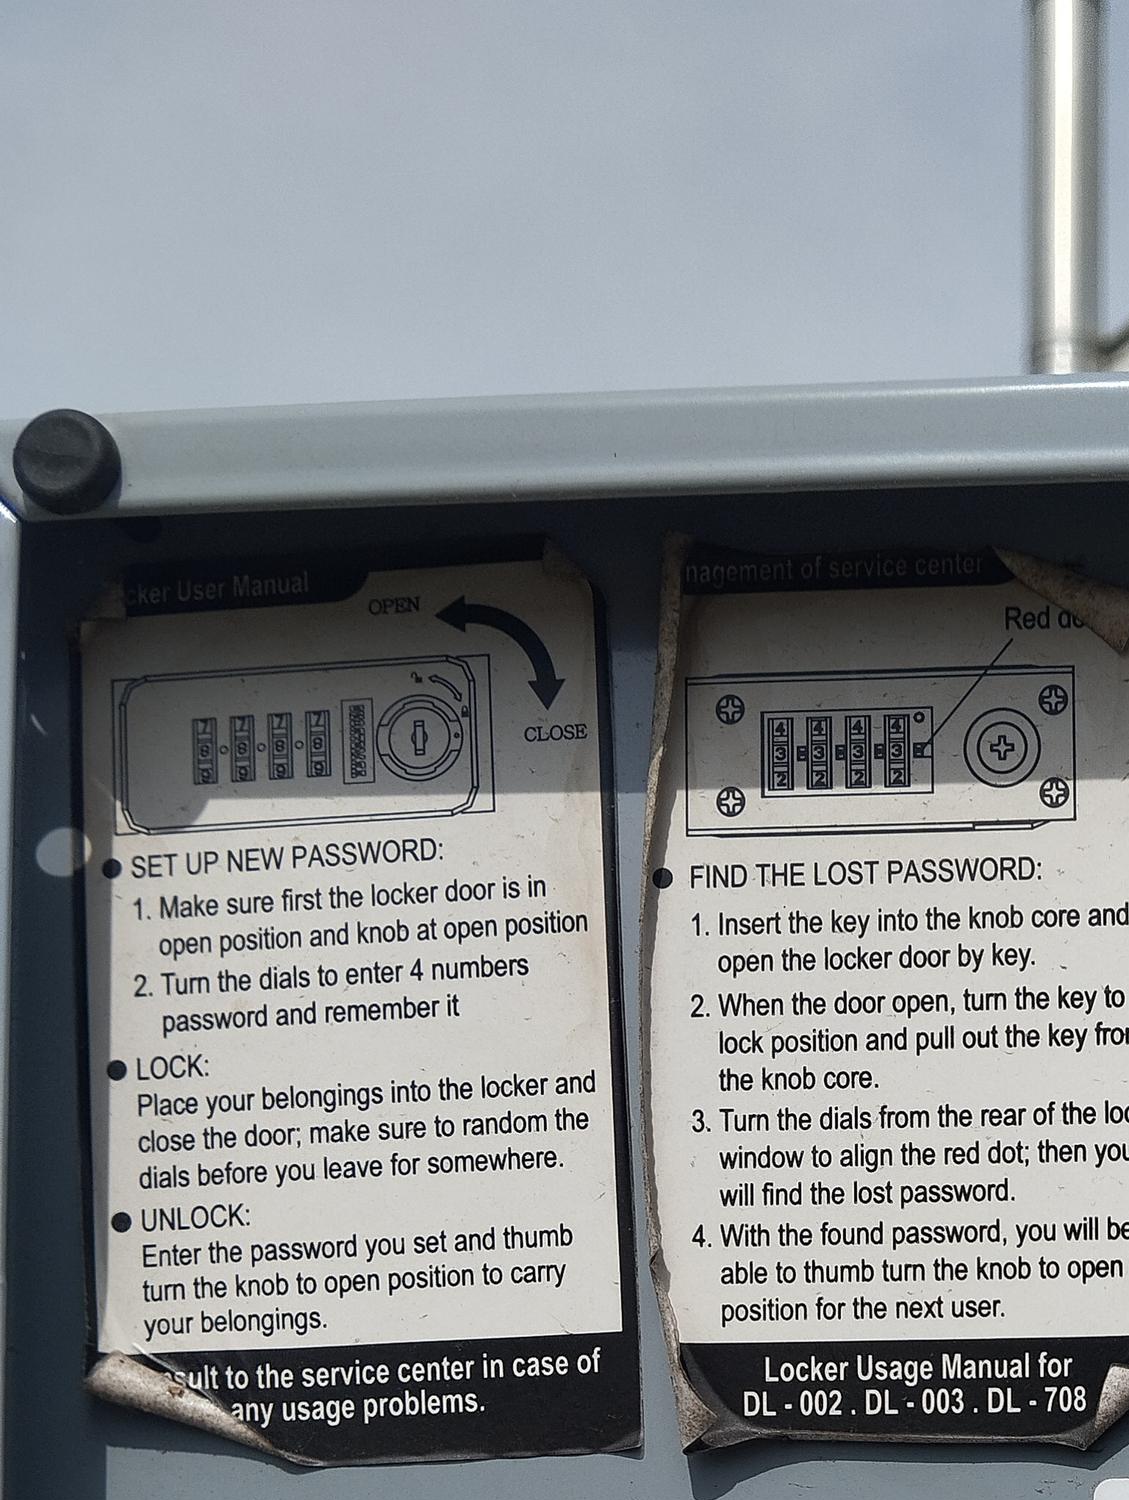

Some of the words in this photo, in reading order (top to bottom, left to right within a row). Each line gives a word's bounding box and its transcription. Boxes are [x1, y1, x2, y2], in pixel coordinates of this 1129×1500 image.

[801, 553, 821, 579] of
[829, 553, 905, 581] service
[916, 555, 982, 577] center
[177, 579, 225, 602] User
[233, 571, 309, 597] Manual
[368, 597, 420, 615] OPEN
[1005, 606, 1050, 630] Red
[523, 724, 588, 743] CLOSE
[130, 852, 179, 880] SET
[185, 850, 219, 876] UP
[226, 845, 285, 873] NEW
[291, 837, 444, 873] PASSWORD:
[690, 862, 748, 890] FIND
[754, 862, 806, 888] THE
[813, 860, 880, 887] LOST
[887, 855, 1042, 885] PASSWORD:
[132, 897, 152, 921] 1.
[159, 893, 220, 920] Make
[226, 894, 275, 916] sure
[280, 887, 324, 913] first
[327, 885, 365, 910] the
[370, 881, 439, 907] locker
[444, 878, 497, 903] door
[502, 875, 521, 900] is
[527, 873, 547, 899] in
[158, 935, 213, 962] open
[219, 925, 302, 959] position
[309, 921, 350, 948] and
[356, 918, 410, 945] knob
[416, 917, 438, 942] at
[443, 918, 498, 946] open
[504, 909, 589, 943] position
[691, 912, 710, 937] 1.
[718, 911, 782, 936] Insert
[787, 909, 824, 935] the
[830, 908, 871, 940] key
[877, 907, 919, 933] into
[924, 906, 961, 932] the
[968, 903, 1024, 930] knob
[1030, 908, 1081, 929] core
[1087, 900, 1129, 928] and
[717, 953, 774, 980] open
[780, 947, 817, 972] the
[824, 945, 894, 971] locker
[898, 944, 952, 969] door
[957, 942, 985, 974] by
[991, 941, 1036, 973] key.
[136, 1053, 210, 1081] LOCK:
[137, 1092, 199, 1122] Place
[205, 1092, 256, 1120] your
[261, 1082, 384, 1114] belongings
[390, 1079, 432, 1104] into
[437, 1076, 474, 1102] the
[480, 1072, 549, 1100] locker
[555, 1068, 596, 1095] and
[140, 1202, 251, 1233] UNLOCK:
[141, 1243, 203, 1269] Enter
[207, 1239, 243, 1265] the
[250, 1233, 358, 1269] password
[364, 1236, 406, 1264] you
[413, 1229, 448, 1255] set
[454, 1226, 496, 1253] and
[502, 1222, 574, 1250] thumb
[225, 1365, 249, 1390] to
[255, 1363, 294, 1389] the
[301, 1359, 390, 1388] service
[397, 1356, 475, 1383] center
[482, 1352, 504, 1379] in
[512, 1355, 569, 1378] case
[576, 1346, 601, 1374] of
[765, 1355, 849, 1382] Locker
[856, 1354, 934, 1387] Usage
[941, 1352, 1030, 1380] Manual
[1037, 1351, 1073, 1378] for
[231, 1400, 274, 1429] any
[282, 1399, 355, 1427] usage
[363, 1389, 485, 1425] problems.
